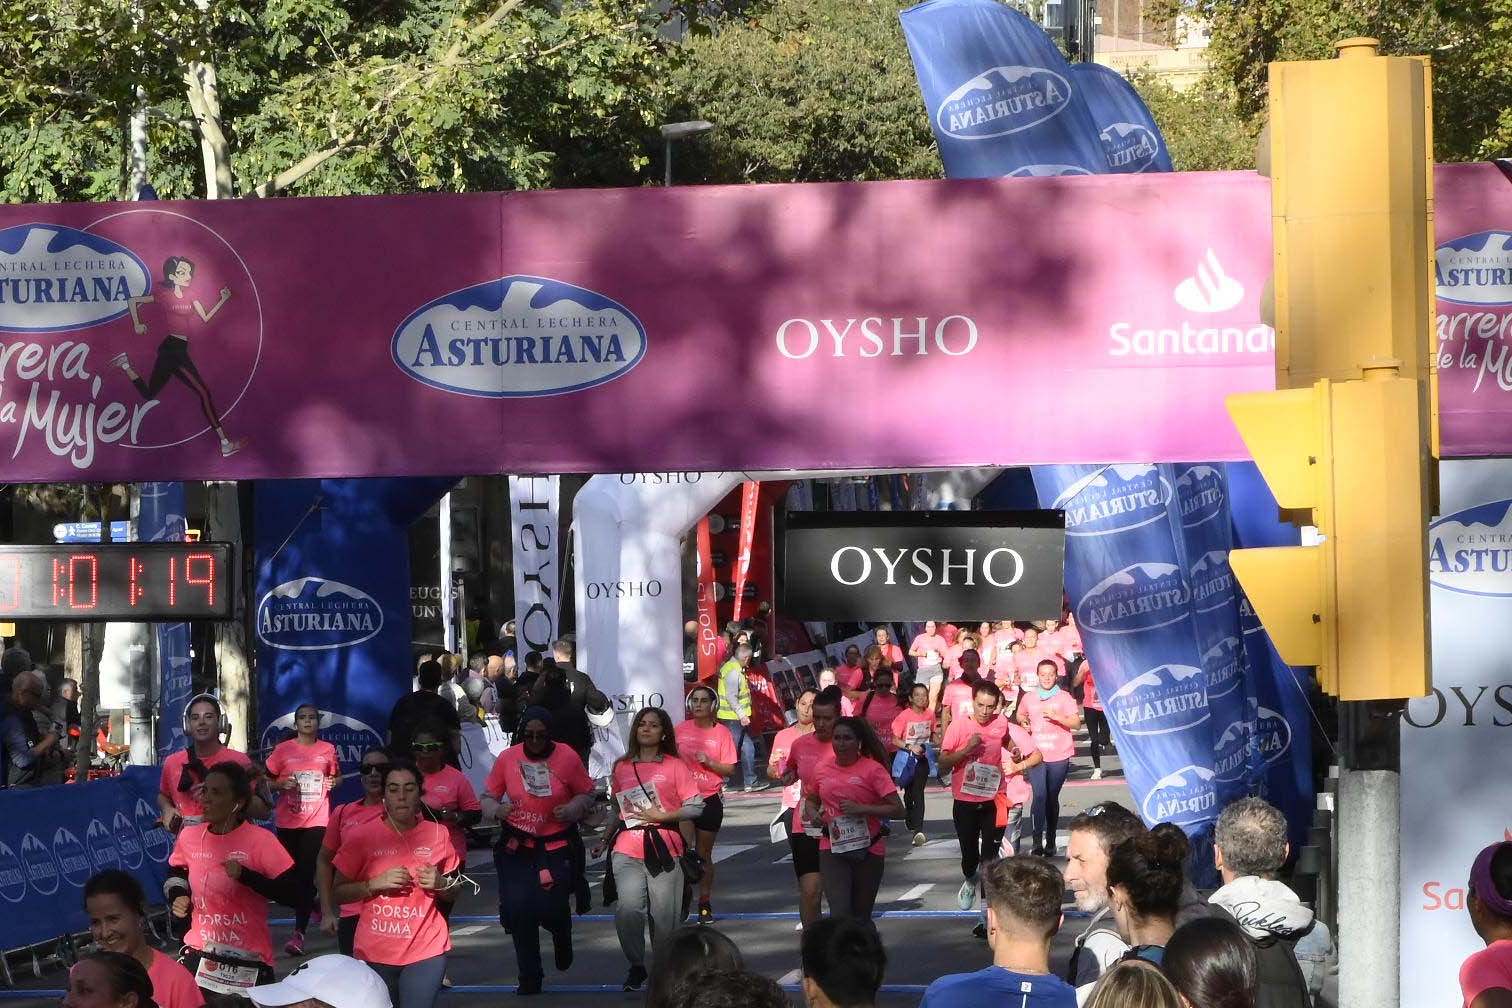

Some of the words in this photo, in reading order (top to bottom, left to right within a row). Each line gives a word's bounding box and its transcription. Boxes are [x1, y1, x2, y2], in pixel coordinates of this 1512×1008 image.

[55, 259, 127, 271] LECHERA
[450, 318, 528, 331] CENTRAL
[537, 316, 619, 329] LECHERA
[412, 323, 627, 368] ASTURIANA
[776, 315, 979, 359] OYSHO
[13, 377, 163, 469] Mujer
[830, 546, 1025, 588] OYSHO
[587, 579, 662, 600] OYSHO
[261, 606, 374, 634] ASTURIANA
[372, 904, 426, 919] DORSAL
[371, 918, 412, 935] SUMA
